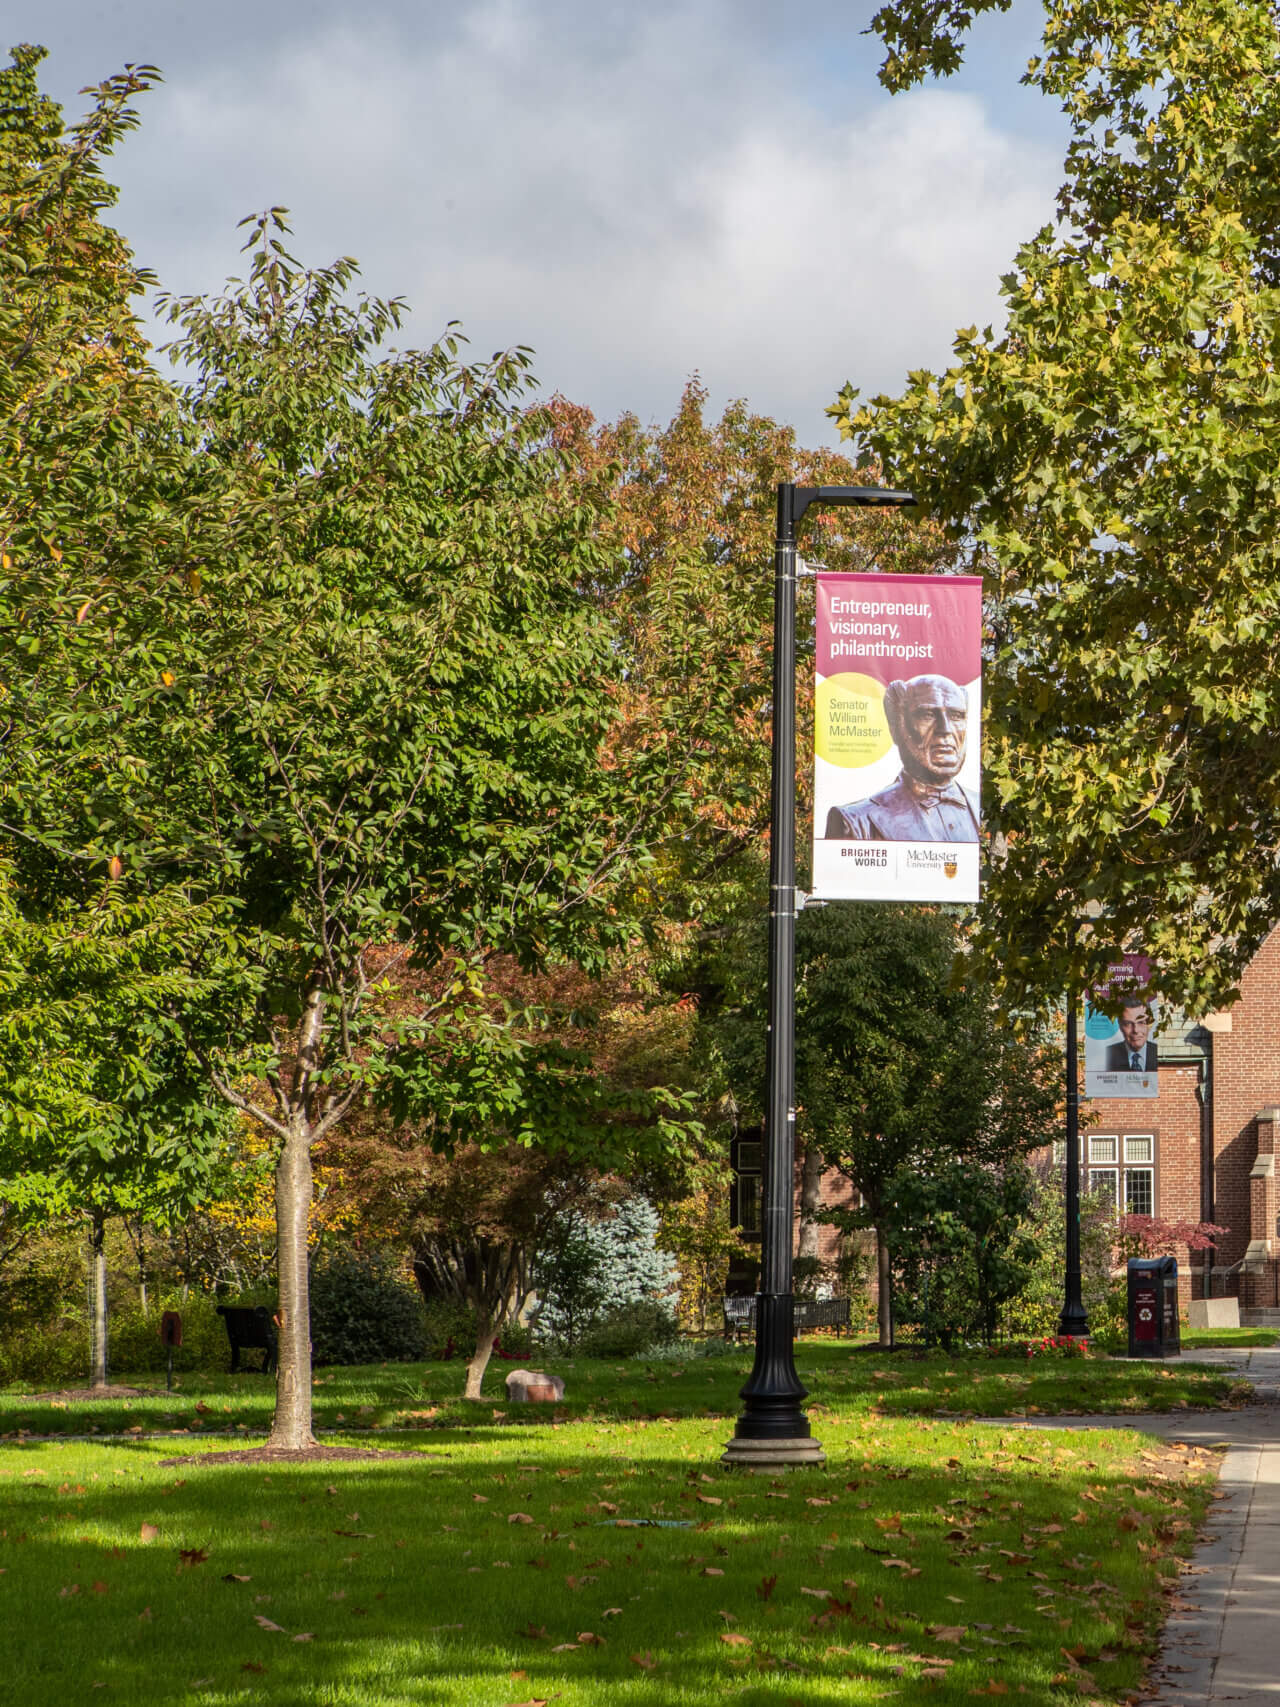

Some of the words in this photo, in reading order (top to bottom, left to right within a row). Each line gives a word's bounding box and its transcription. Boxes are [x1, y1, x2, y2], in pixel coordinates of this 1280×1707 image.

[830, 596, 932, 619] Entrepreneur,
[829, 618, 901, 640] visionary,
[830, 639, 933, 661] philanthropist
[829, 698, 869, 710] Senator
[829, 711, 867, 723] William
[829, 725, 884, 737] McMaster
[840, 848, 888, 858] BRIGHTER
[906, 849, 958, 862] McMaster
[854, 857, 887, 867] WORLD
